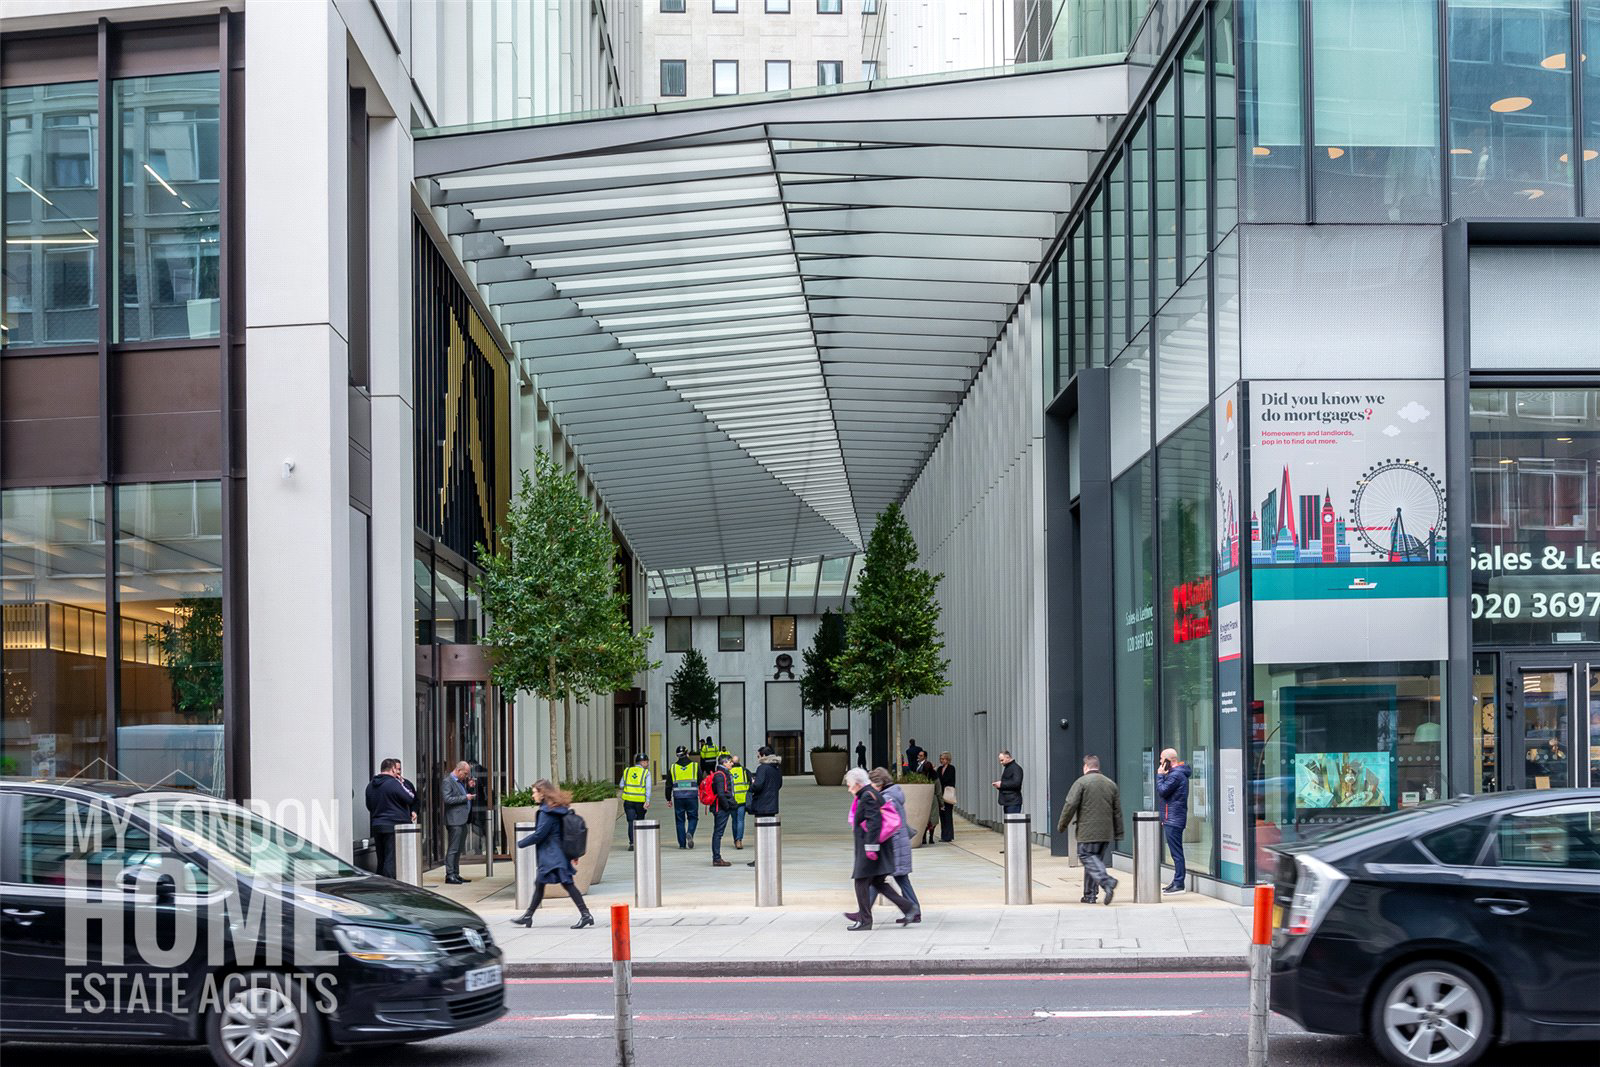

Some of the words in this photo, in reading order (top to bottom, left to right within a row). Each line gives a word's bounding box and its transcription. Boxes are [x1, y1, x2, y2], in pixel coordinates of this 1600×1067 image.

[1261, 392, 1288, 405] Did
[1292, 395, 1318, 409] you
[1321, 392, 1362, 405] know
[1365, 394, 1385, 405] we
[1261, 408, 1281, 421] do
[1284, 407, 1373, 424] mortgages?
[1320, 429, 1354, 437] landlords,
[1541, 545, 1567, 570] &
[1471, 592, 1521, 619] 020
[1532, 591, 1600, 618] 3697
